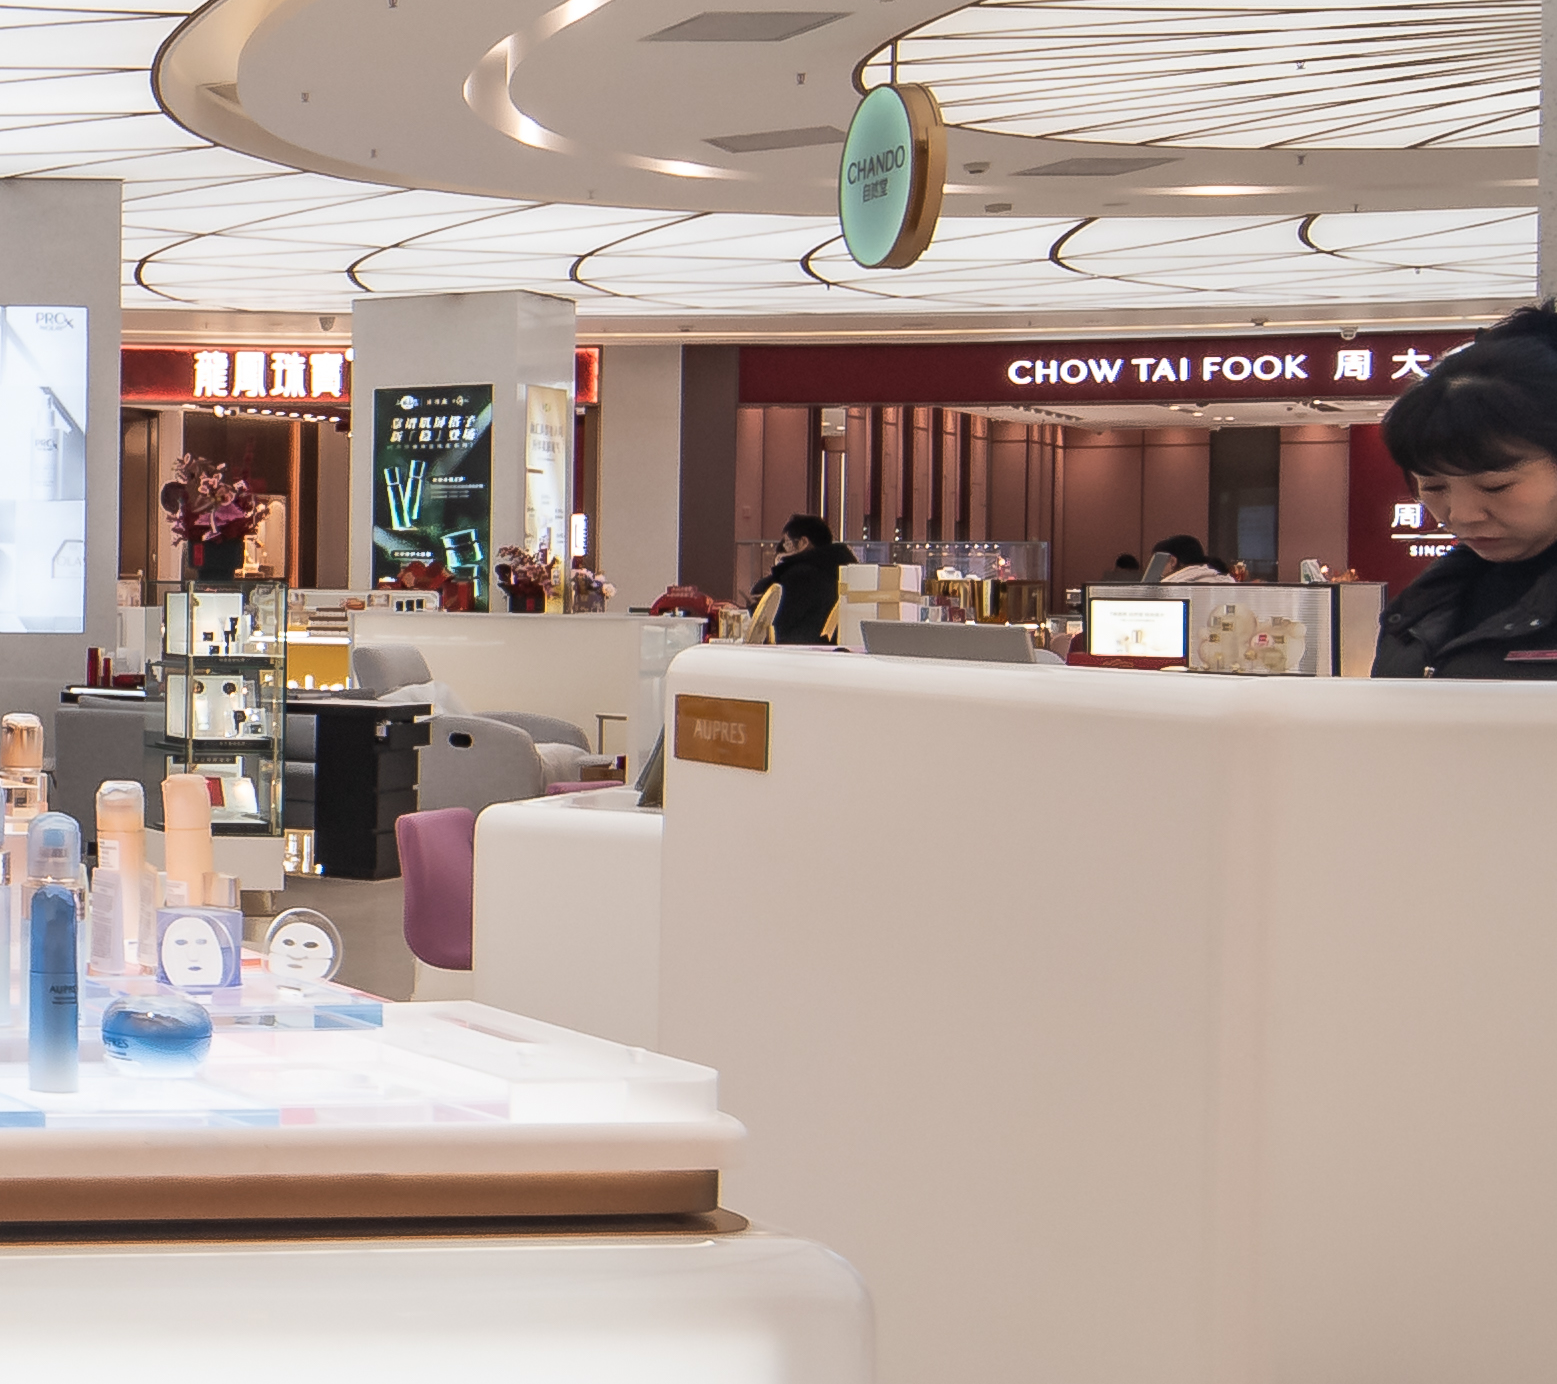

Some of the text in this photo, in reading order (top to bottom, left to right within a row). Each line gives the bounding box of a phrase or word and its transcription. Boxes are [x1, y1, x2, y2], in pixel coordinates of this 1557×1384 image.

[847, 145, 905, 185] CHANDO
[1007, 358, 1124, 386] CHOW
[1131, 356, 1191, 383] TAI
[1202, 353, 1309, 382] FOOK
[693, 717, 746, 745] AUPRES
